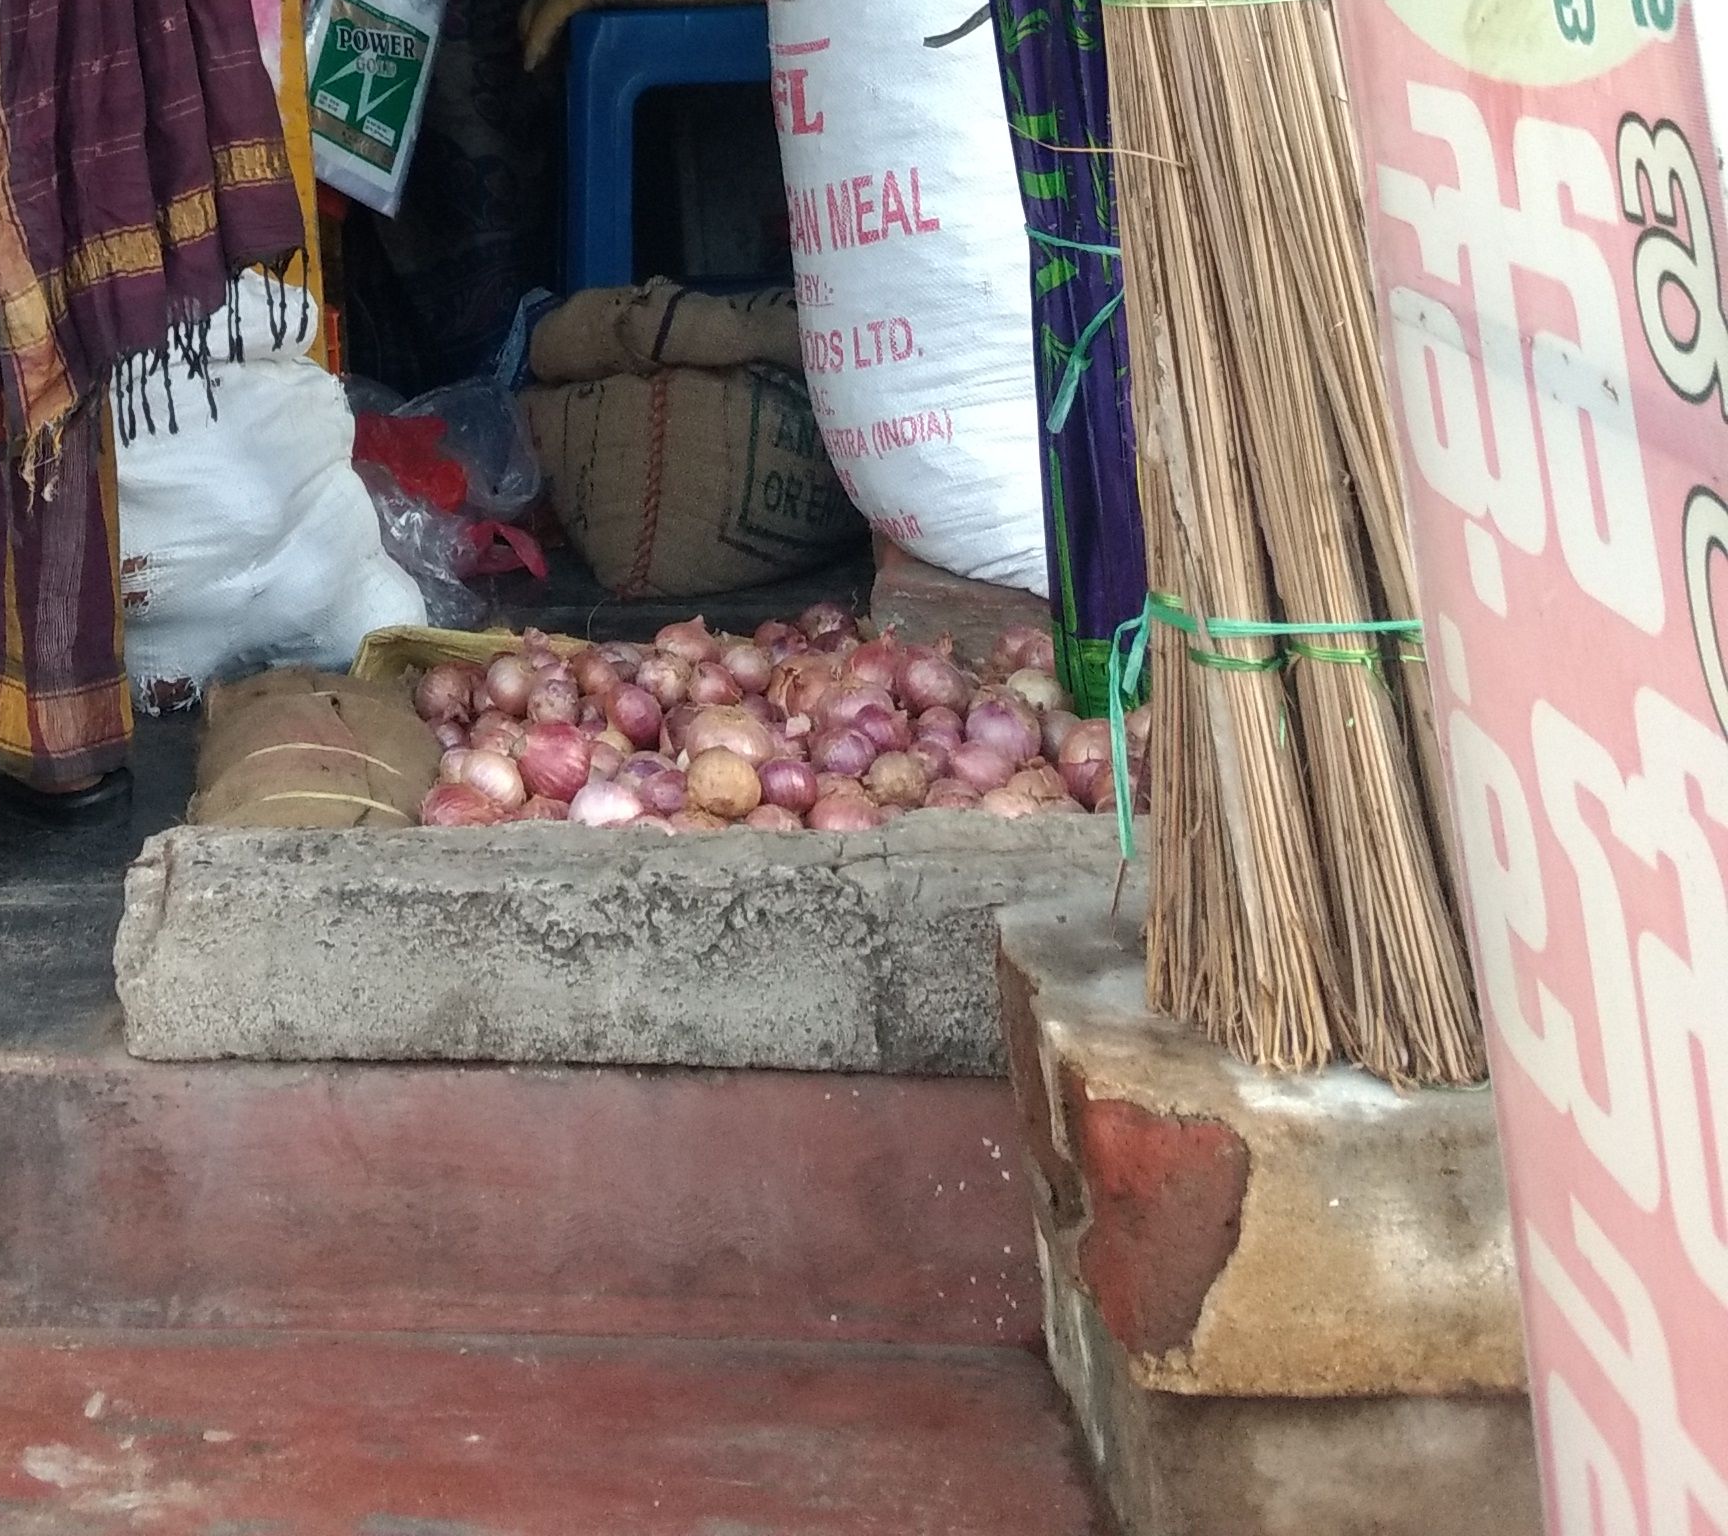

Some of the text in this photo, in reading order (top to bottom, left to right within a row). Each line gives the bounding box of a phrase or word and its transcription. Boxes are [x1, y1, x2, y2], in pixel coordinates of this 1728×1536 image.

[335, 25, 416, 61] POWER
[825, 167, 941, 250] MEAL
[852, 316, 925, 371] LTD.
[871, 409, 954, 460] (INDIA)
